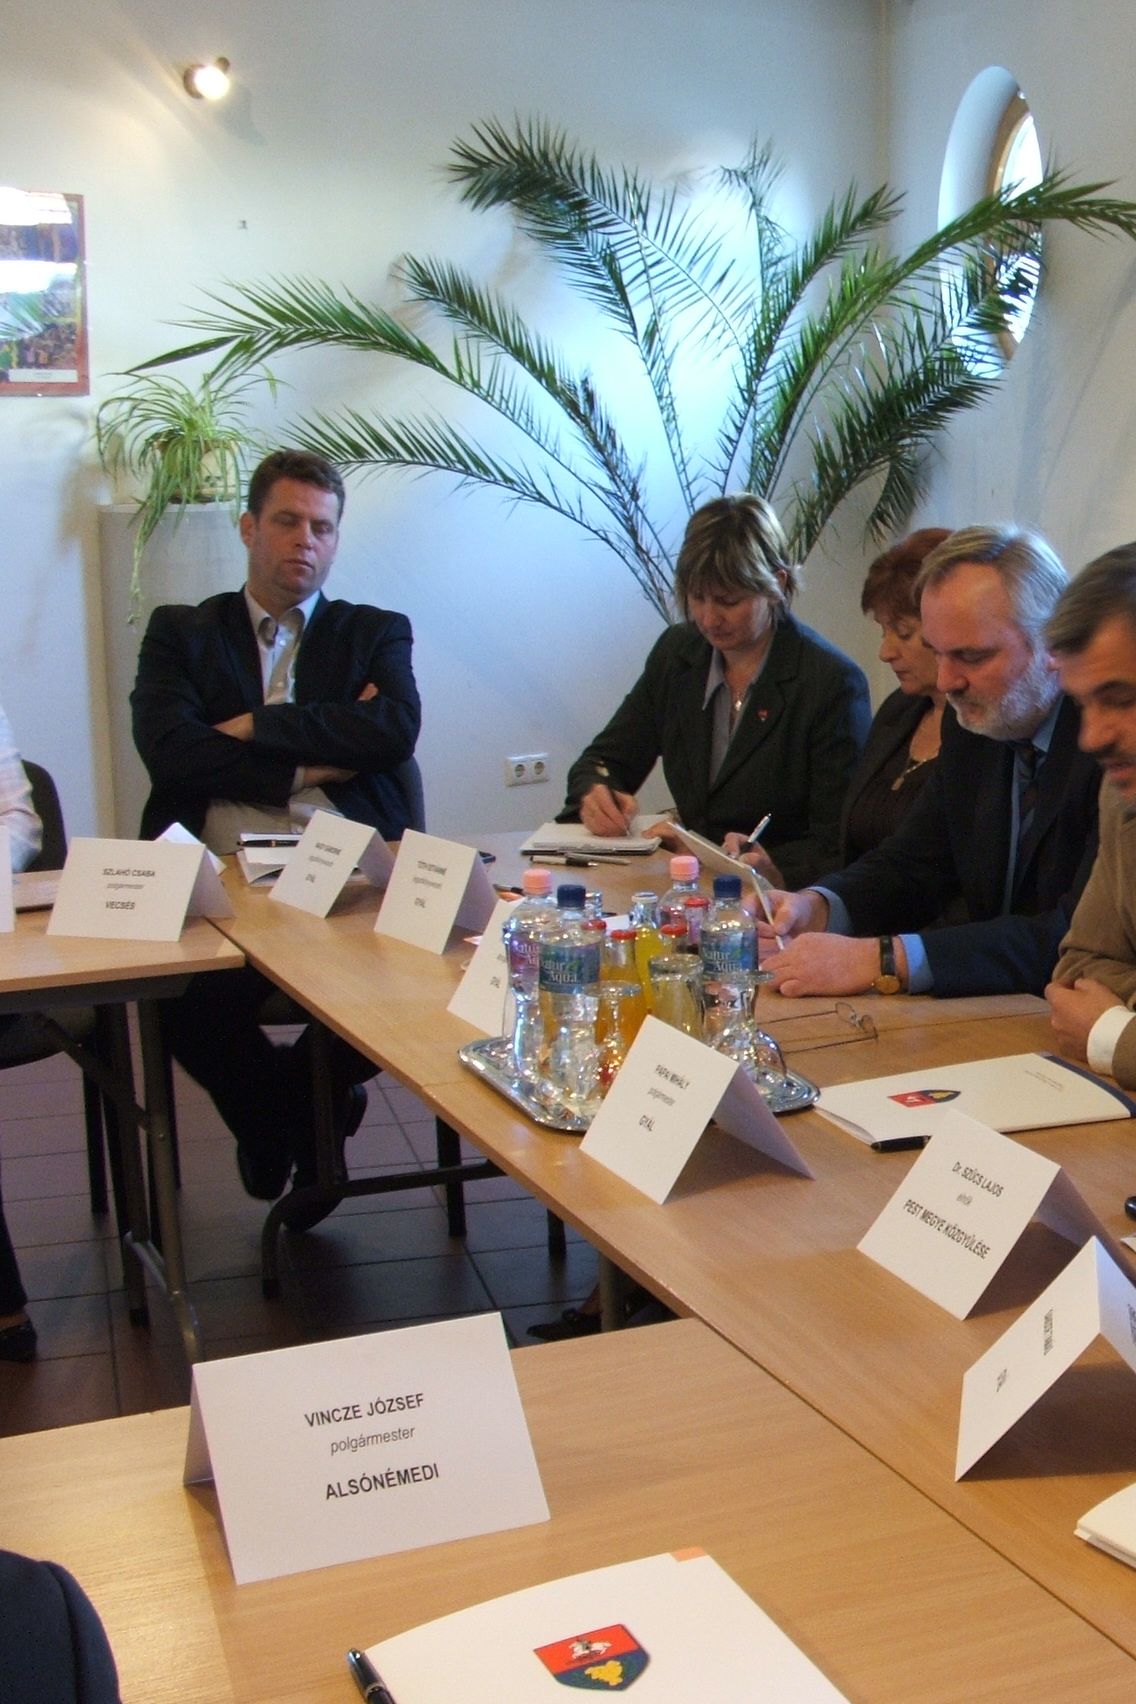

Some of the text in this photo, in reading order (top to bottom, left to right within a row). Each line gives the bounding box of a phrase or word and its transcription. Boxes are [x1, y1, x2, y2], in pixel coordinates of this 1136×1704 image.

[980, 1178, 1004, 1197] LAJOS
[903, 1199, 924, 1218] PEST
[920, 1209, 947, 1232] MEGYE
[304, 1392, 424, 1428] VINCZE JÓZSEF
[330, 1427, 416, 1457] polgármester
[325, 1462, 440, 1501] ALSÓNÉMEDI
